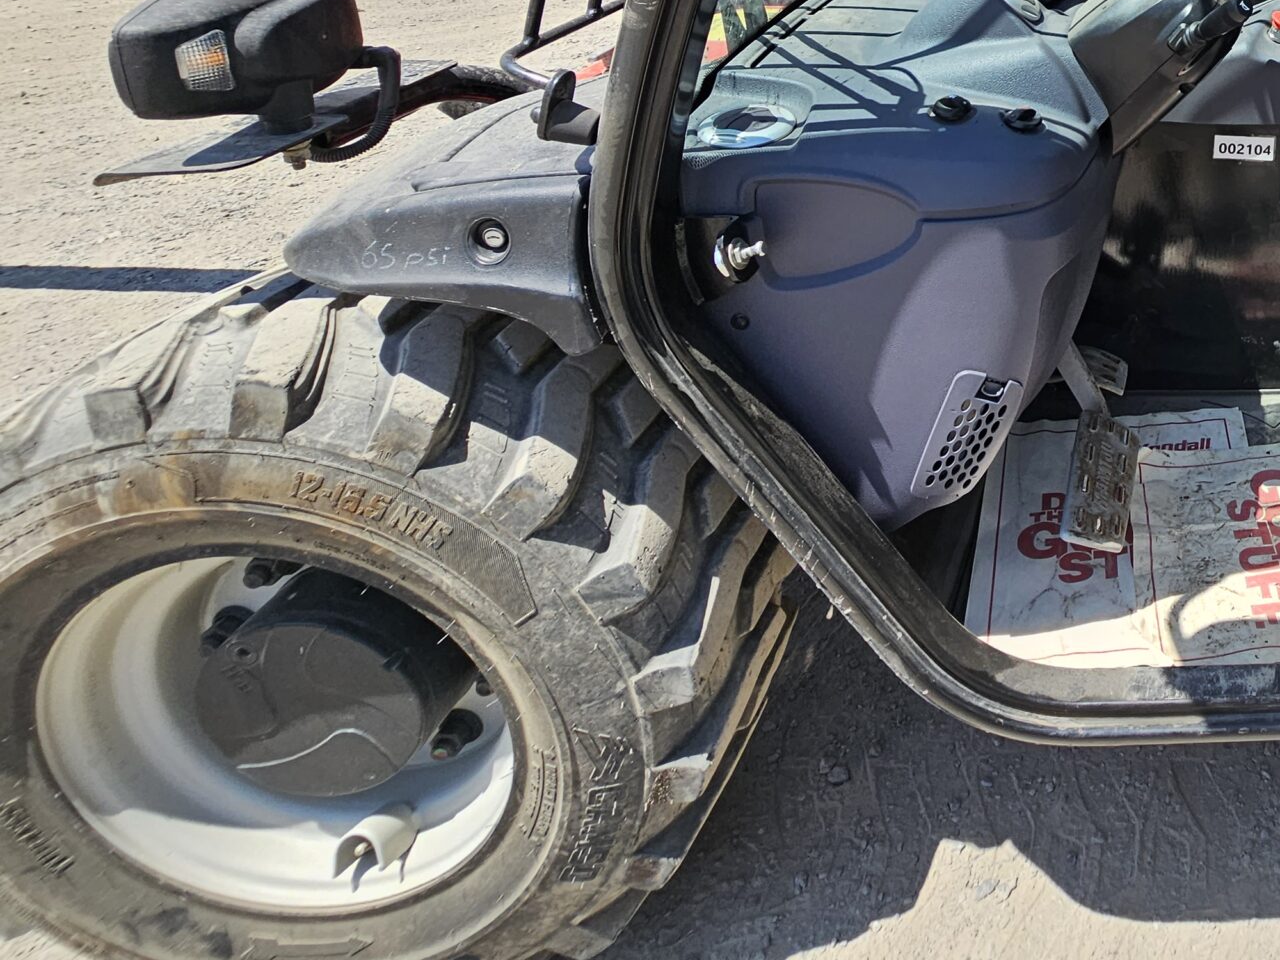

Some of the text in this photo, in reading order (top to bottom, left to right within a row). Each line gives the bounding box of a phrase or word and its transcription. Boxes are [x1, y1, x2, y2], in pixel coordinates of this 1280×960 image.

[1219, 143, 1271, 156] 002104
[361, 240, 451, 271] 65 psi
[1142, 438, 1211, 451] ndall
